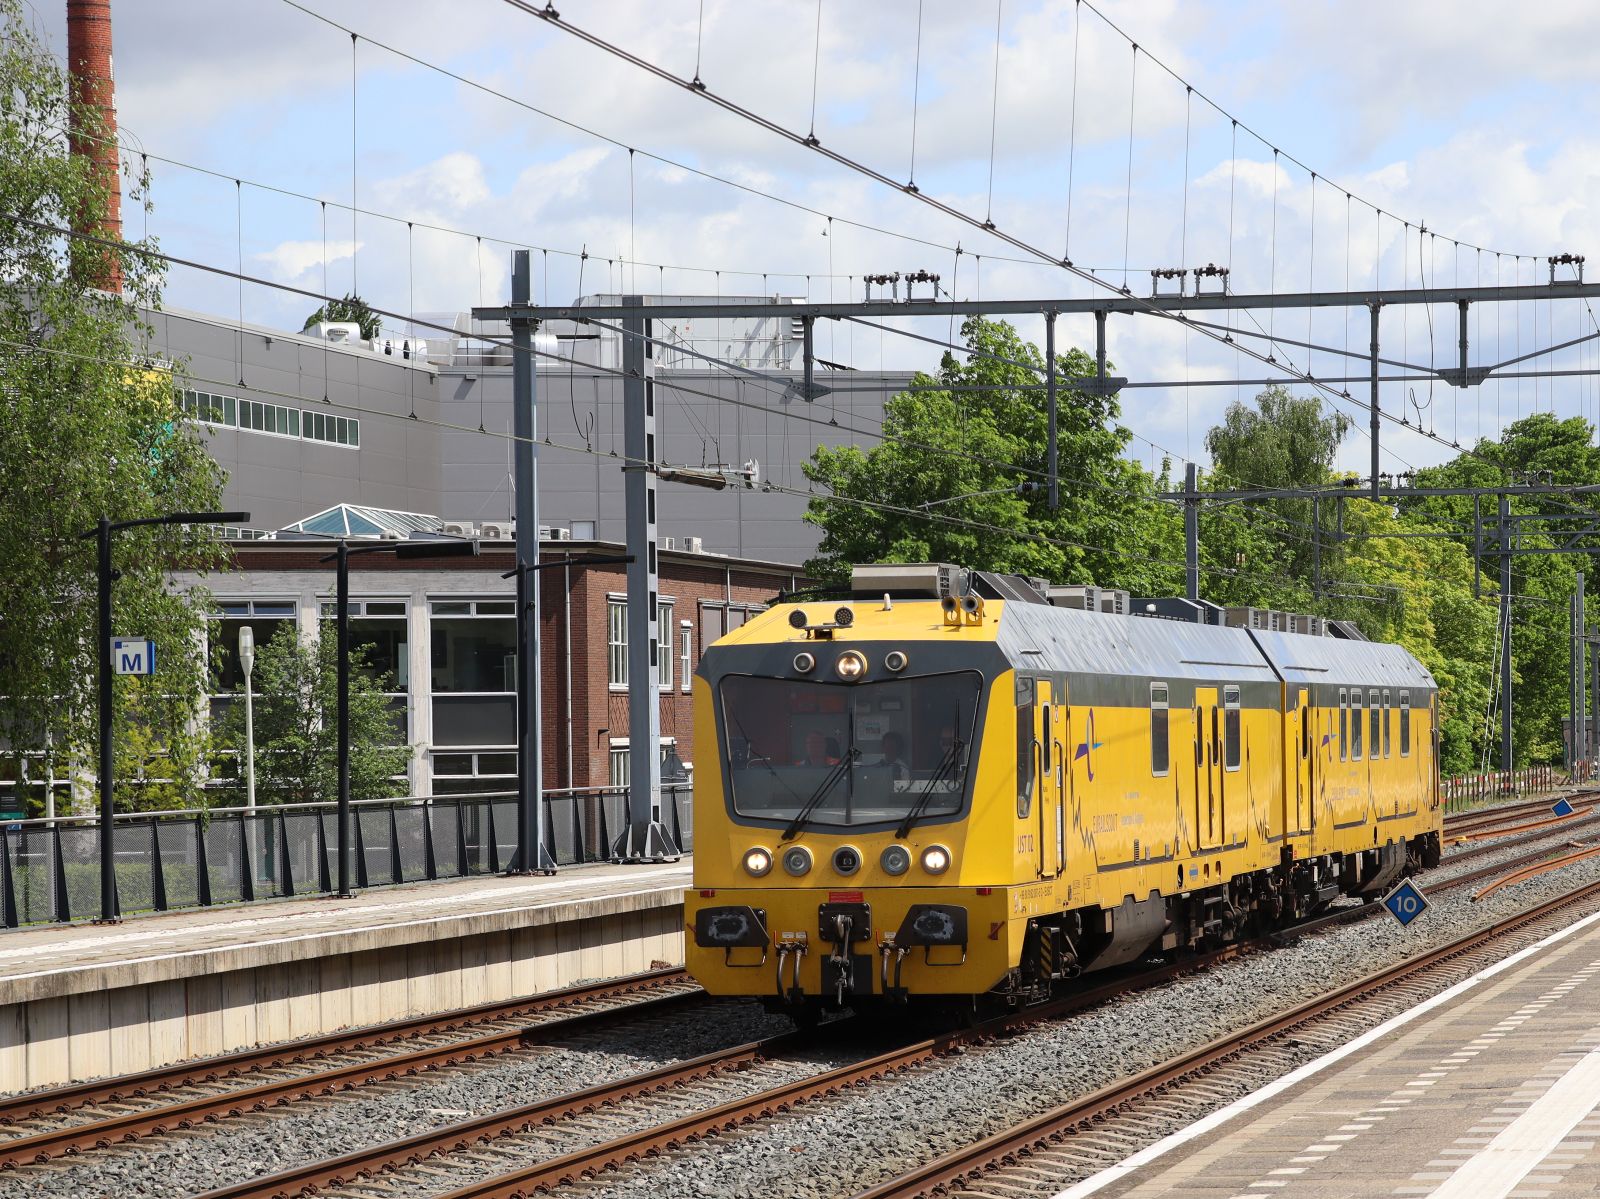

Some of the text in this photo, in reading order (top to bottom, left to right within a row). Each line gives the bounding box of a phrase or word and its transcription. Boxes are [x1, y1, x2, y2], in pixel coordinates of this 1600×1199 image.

[122, 654, 142, 672] M
[1017, 833, 1034, 854] UST 02
[1396, 895, 1417, 913] 10
